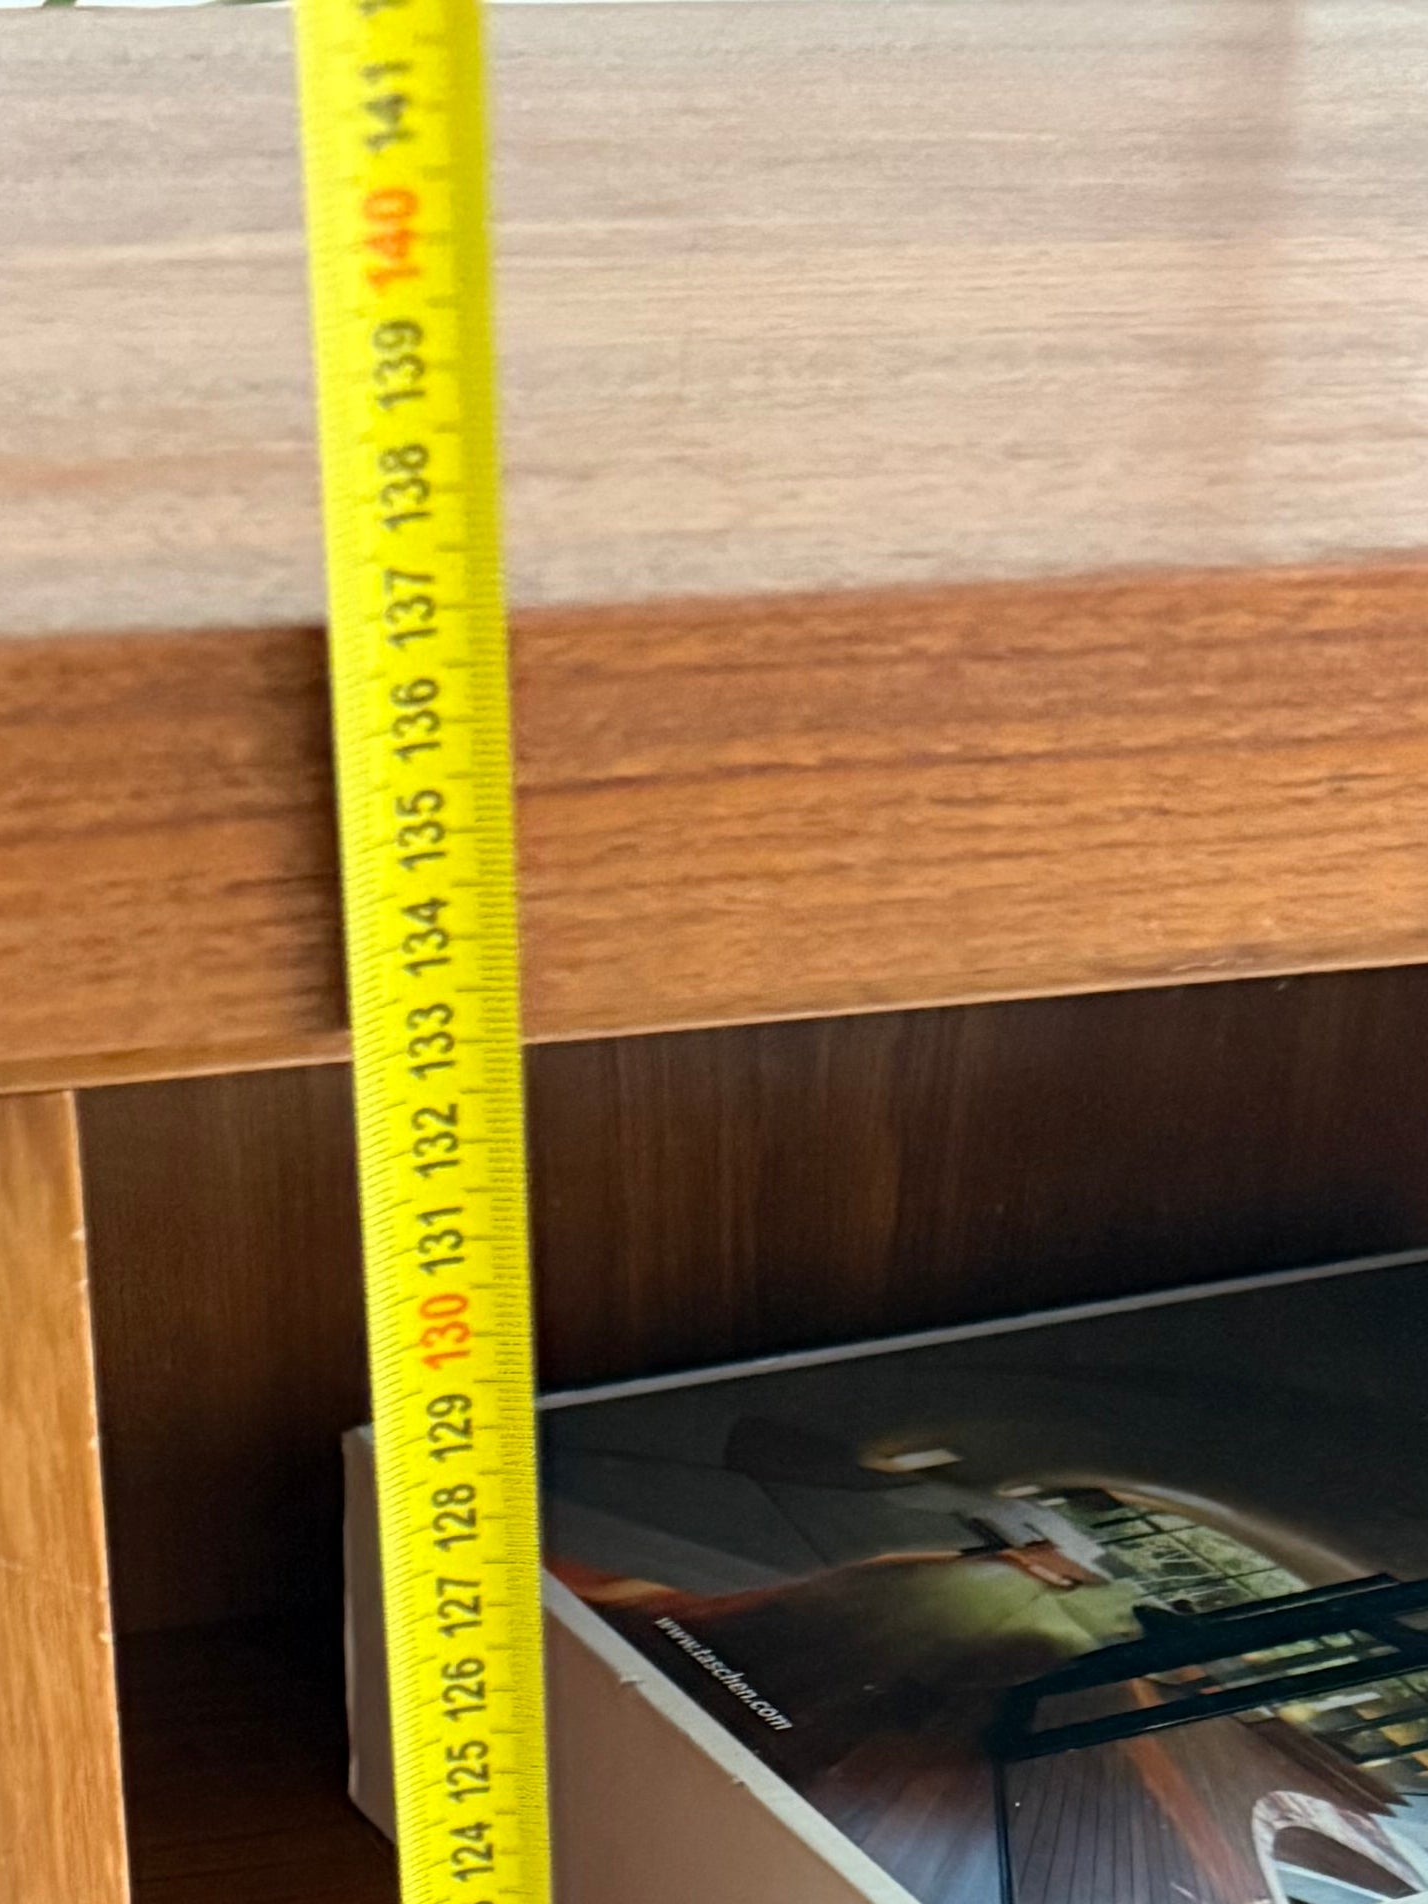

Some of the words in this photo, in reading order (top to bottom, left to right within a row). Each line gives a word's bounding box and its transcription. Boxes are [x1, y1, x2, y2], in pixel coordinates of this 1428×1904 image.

[362, 58, 413, 152] 141
[368, 185, 420, 291] 140
[375, 317, 426, 410] 139
[381, 441, 431, 531] 138
[386, 566, 437, 648] 137
[392, 676, 442, 761] 136
[397, 787, 447, 871] 135
[402, 896, 452, 977] 134
[407, 1001, 457, 1079] 133
[412, 1103, 462, 1179] 132
[417, 1205, 466, 1275] 131
[421, 1291, 471, 1370] 130
[427, 1392, 475, 1463] 129
[431, 1482, 479, 1552] 128
[436, 1575, 483, 1638] 127
[440, 1656, 487, 1722] 126
[654, 1616, 793, 1731] www.taschen.com
[445, 1739, 491, 1803] 125
[449, 1820, 495, 1883] 124
